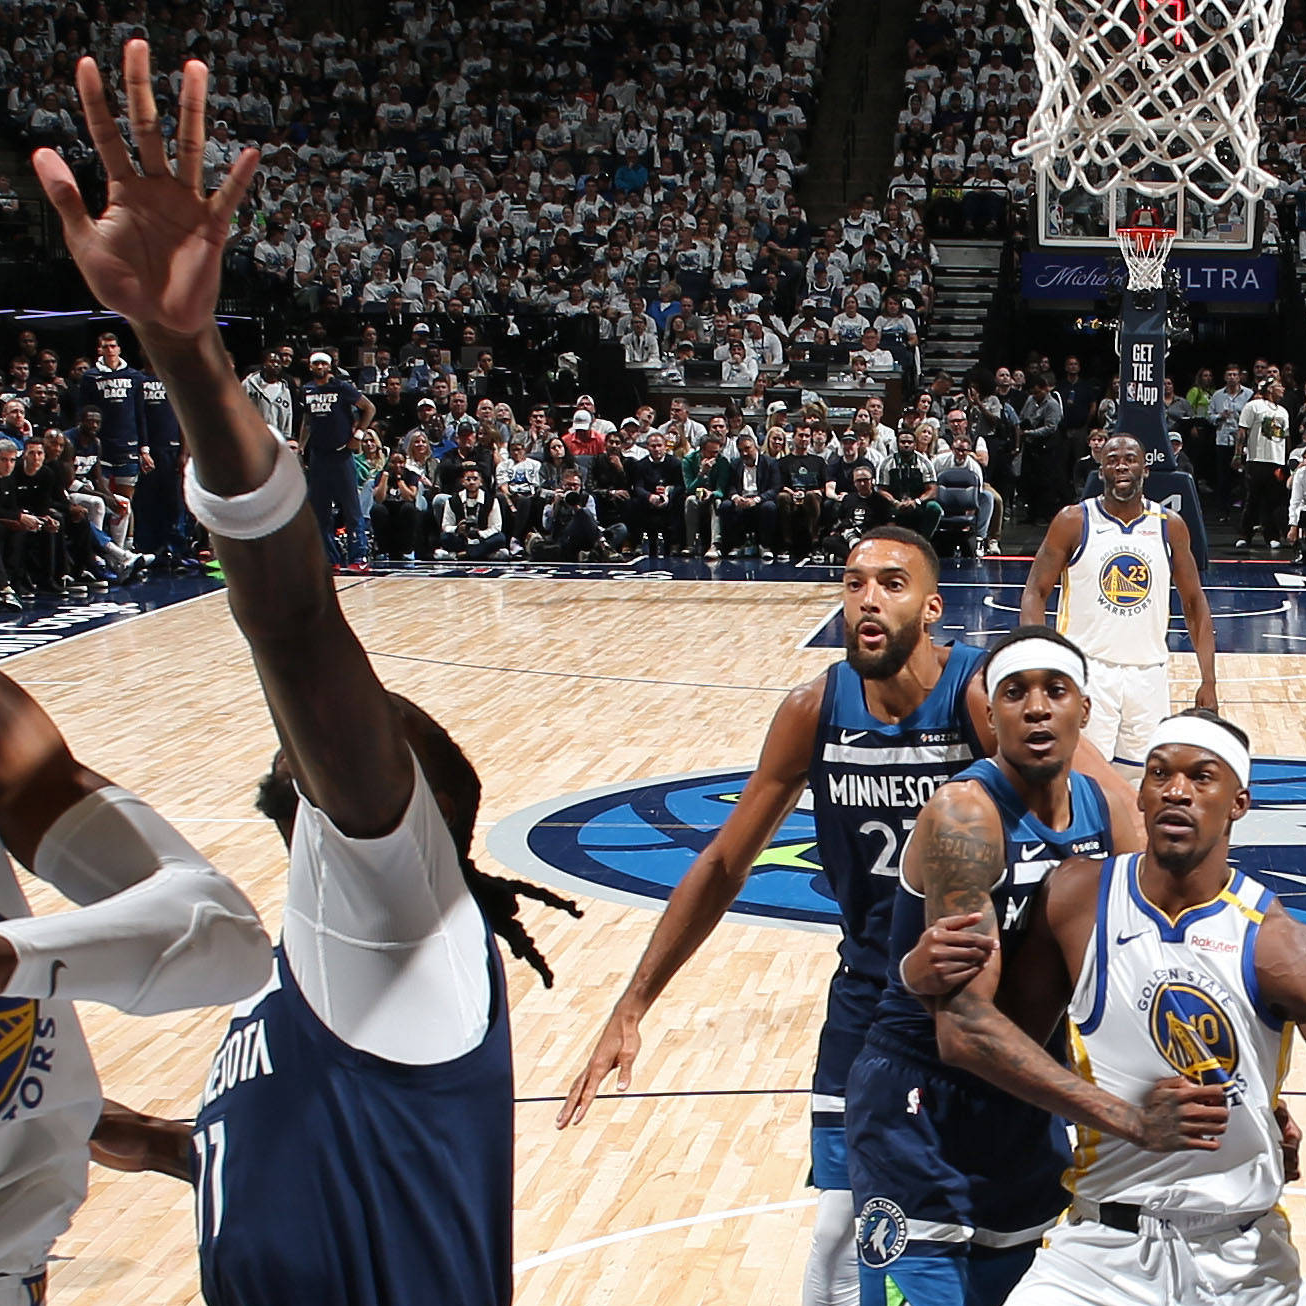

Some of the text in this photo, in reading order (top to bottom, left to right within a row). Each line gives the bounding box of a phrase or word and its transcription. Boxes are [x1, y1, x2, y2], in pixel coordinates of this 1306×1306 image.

[1132, 343, 1154, 362] GET
[1132, 363, 1154, 382] THE
[1136, 382, 1158, 405] App
[1144, 448, 1166, 468] gle
[1127, 565, 1148, 582] 23
[1096, 594, 1153, 617] WARRIORS
[828, 773, 950, 808] MINNESOT
[1191, 935, 1238, 953] Rakuten
[1186, 970, 1231, 1008] STATE
[192, 1120, 226, 1246] 11
